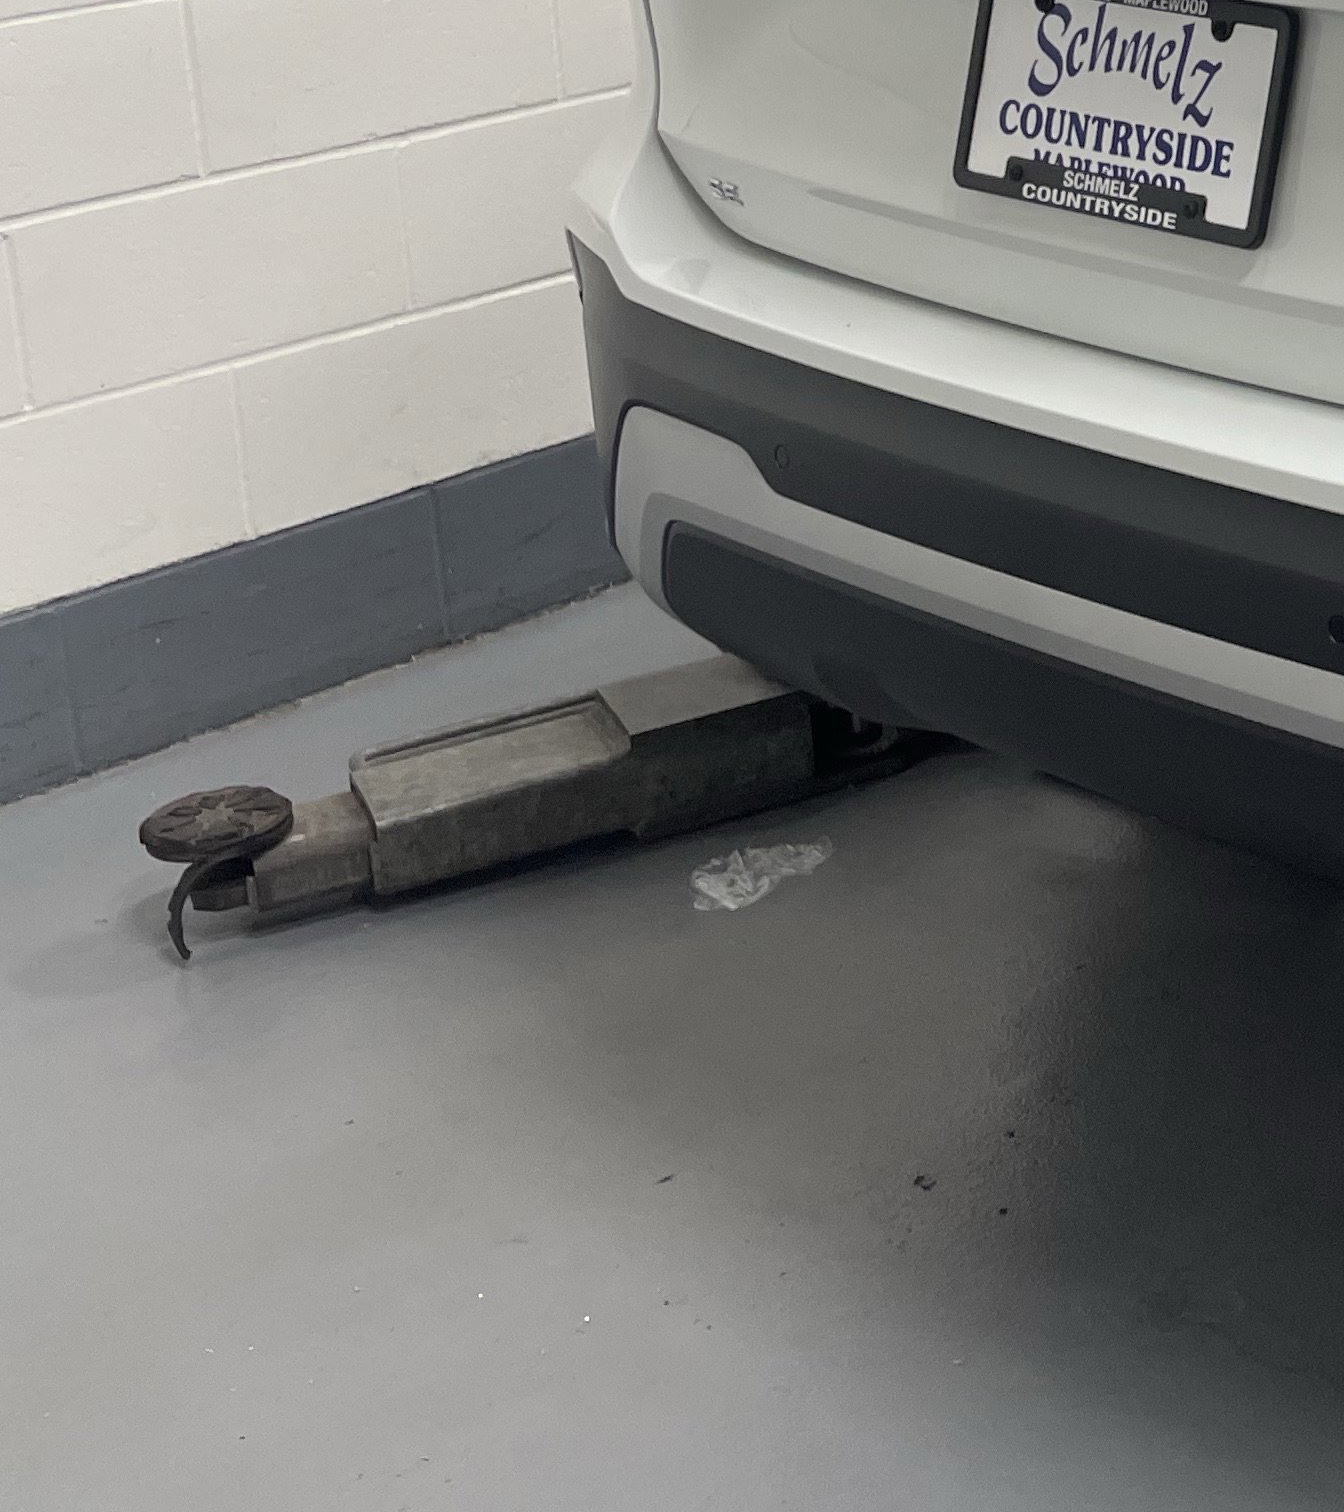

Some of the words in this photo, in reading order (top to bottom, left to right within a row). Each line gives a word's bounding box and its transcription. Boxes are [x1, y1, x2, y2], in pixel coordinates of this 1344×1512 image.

[1028, 3, 1223, 128] Schmelz
[999, 98, 1234, 178] COUNTRYSIDE
[1021, 182, 1178, 230] COUNTRYSIDE
[1062, 170, 1140, 202] SCHMELZ
